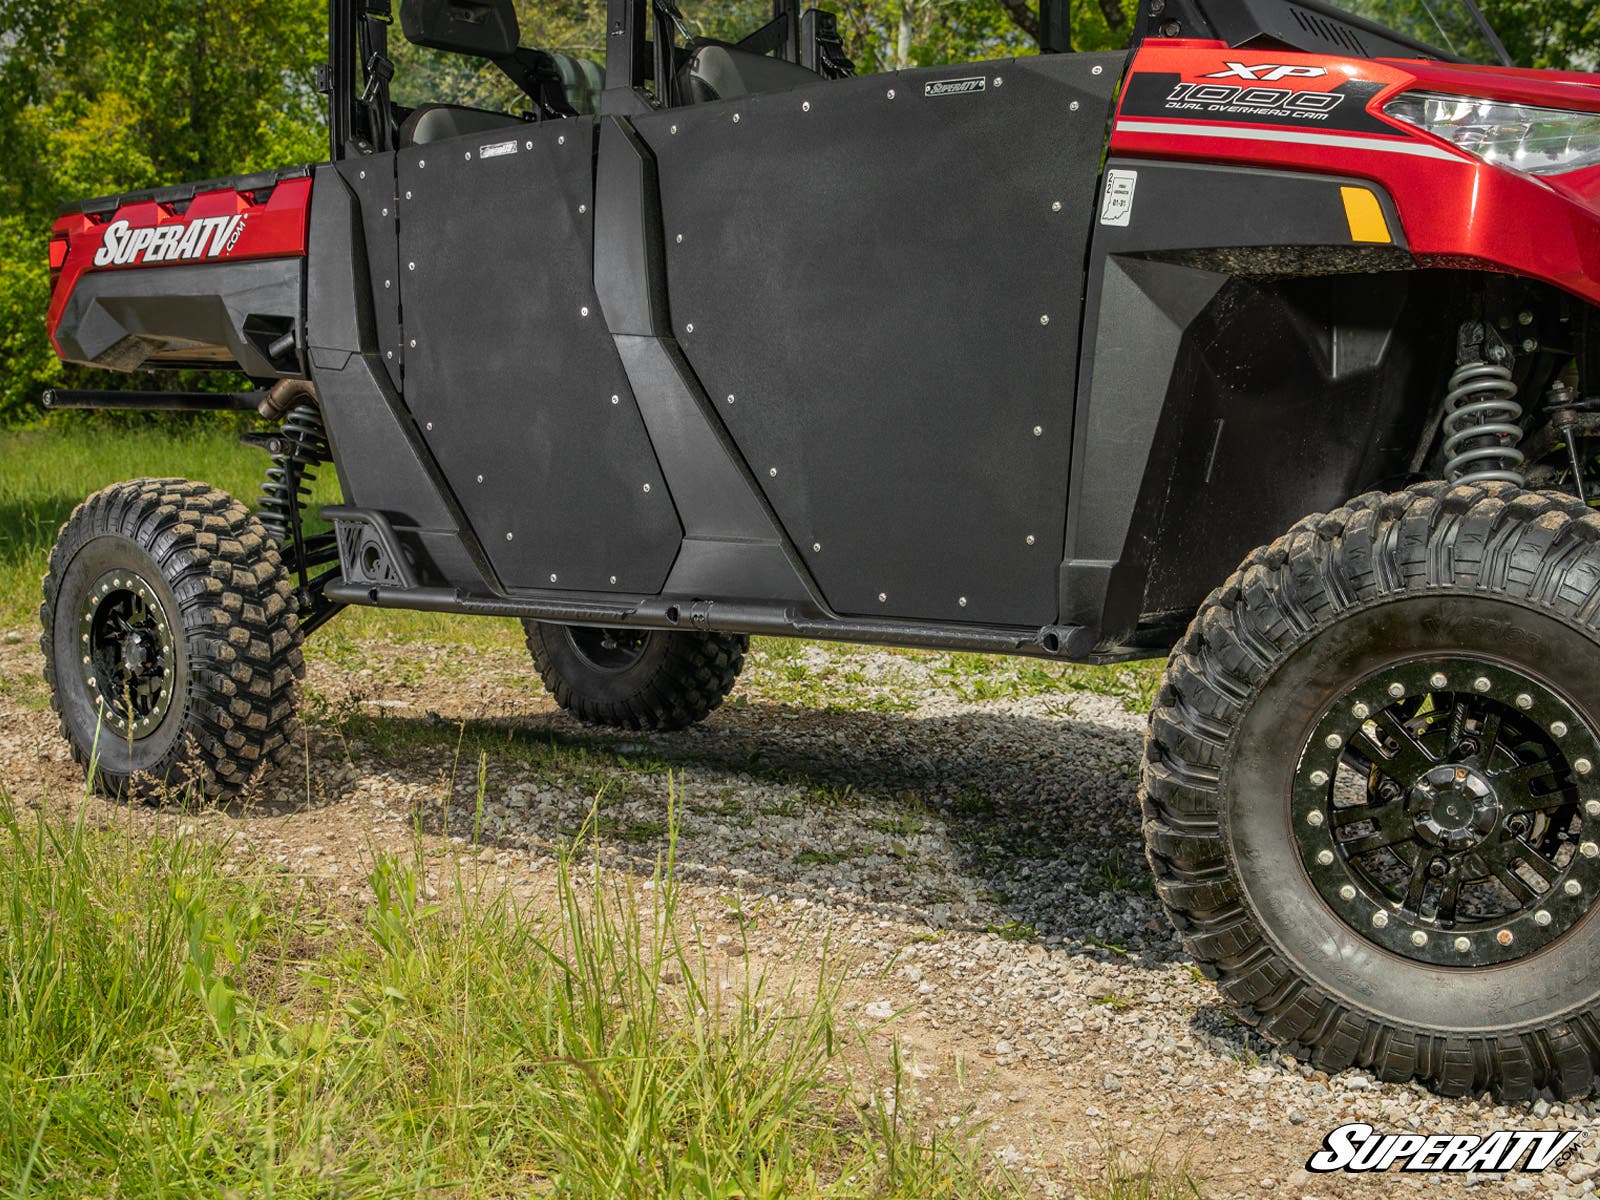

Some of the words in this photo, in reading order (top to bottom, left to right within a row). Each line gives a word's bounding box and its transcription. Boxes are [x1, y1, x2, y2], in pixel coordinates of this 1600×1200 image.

[1200, 61, 1328, 81] XP
[1166, 82, 1345, 112] 1000
[1164, 101, 1204, 110] DUAL
[1207, 104, 1289, 118] OVERHEAD
[1292, 111, 1329, 121] CAM
[94, 214, 242, 267] SUPERATV
